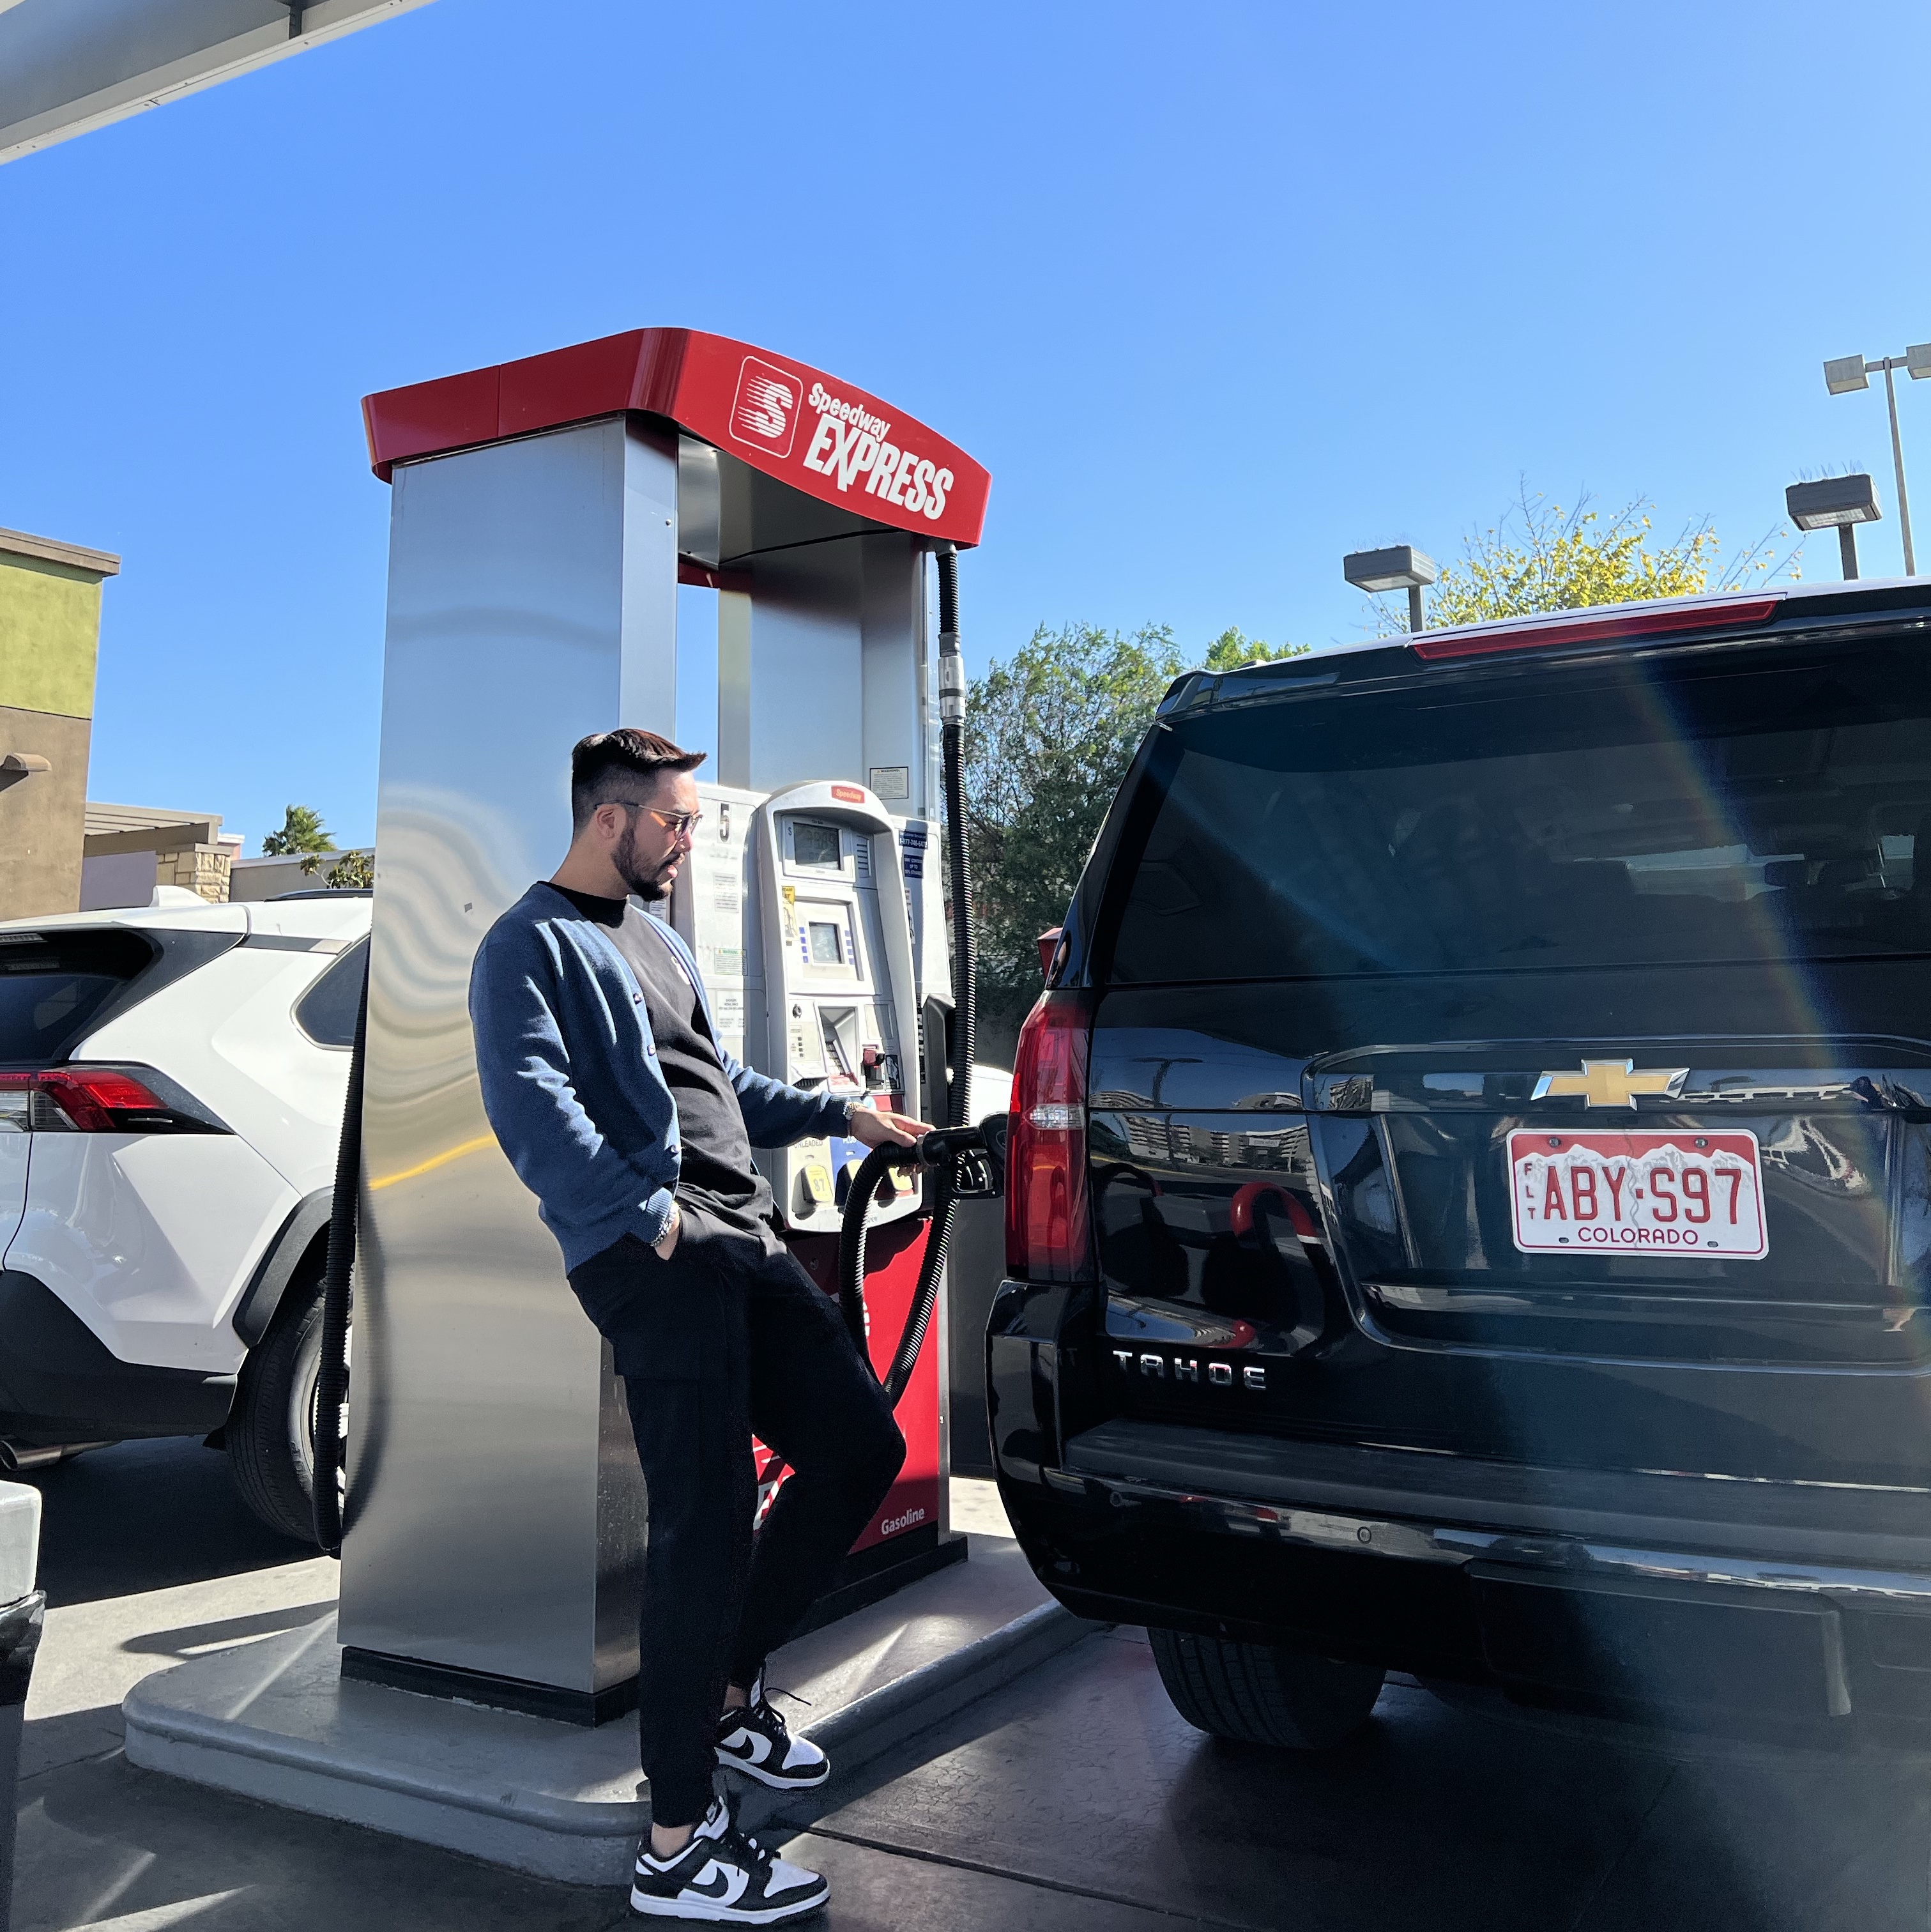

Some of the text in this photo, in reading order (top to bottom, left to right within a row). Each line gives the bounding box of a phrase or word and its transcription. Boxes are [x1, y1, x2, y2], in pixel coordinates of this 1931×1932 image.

[808, 382, 892, 442] Speedway
[802, 413, 954, 520] EXPRESS
[836, 788, 862, 802] Speedway
[719, 802, 729, 843] 5
[813, 1178, 825, 1192] 87
[1578, 1227, 1698, 1245] COLORADO
[1112, 1349, 1266, 1391] TAHOE
[882, 1508, 925, 1535] Gasoline
